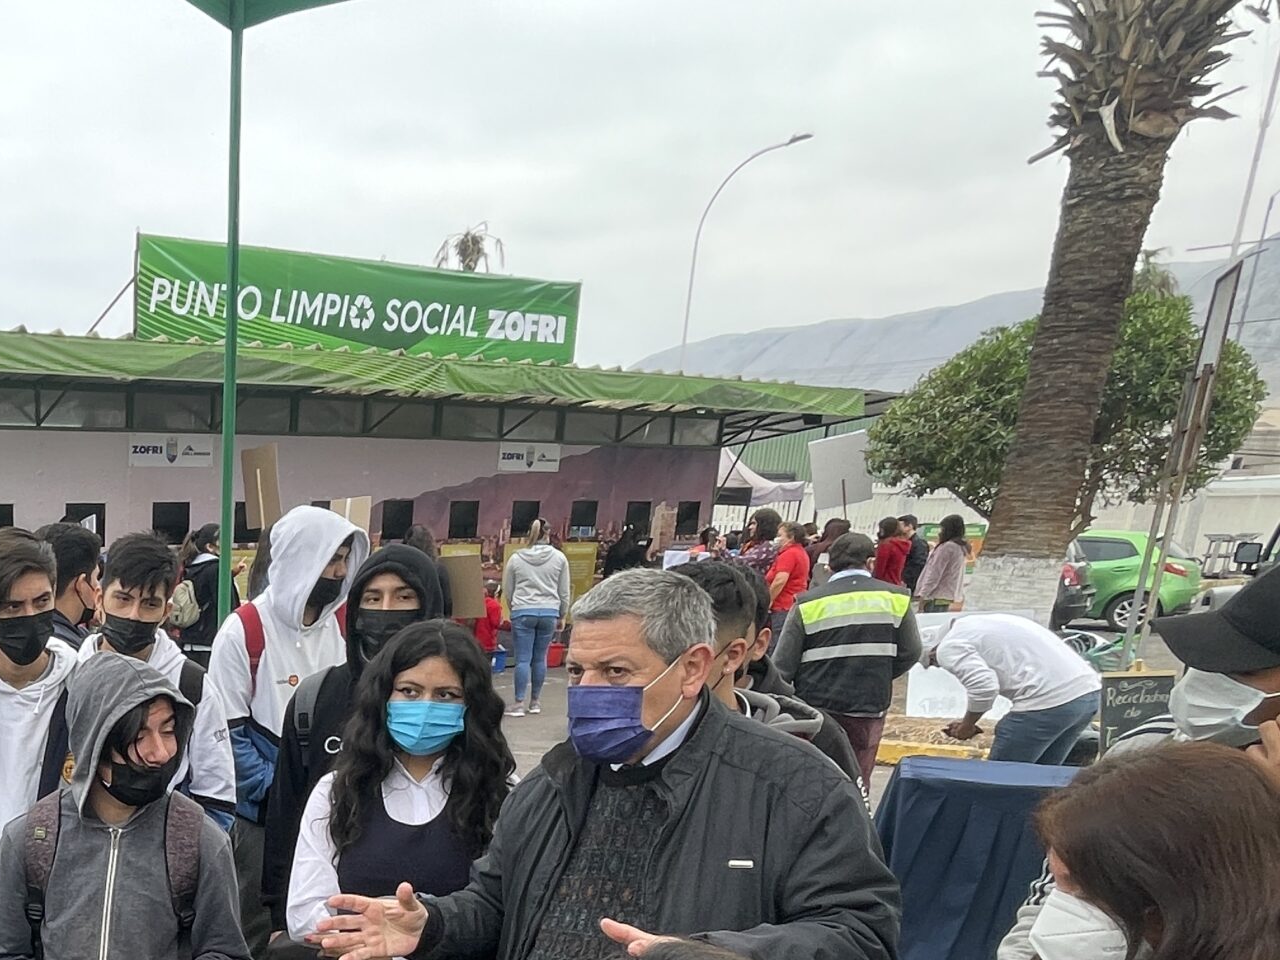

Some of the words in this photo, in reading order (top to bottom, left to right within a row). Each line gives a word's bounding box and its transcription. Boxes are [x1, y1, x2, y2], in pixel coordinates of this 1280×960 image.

[382, 298, 479, 338] SOCIAL
[485, 309, 567, 344] ZOFRI
[131, 445, 163, 454] ZOFRI
[502, 452, 524, 460] ZOFRI
